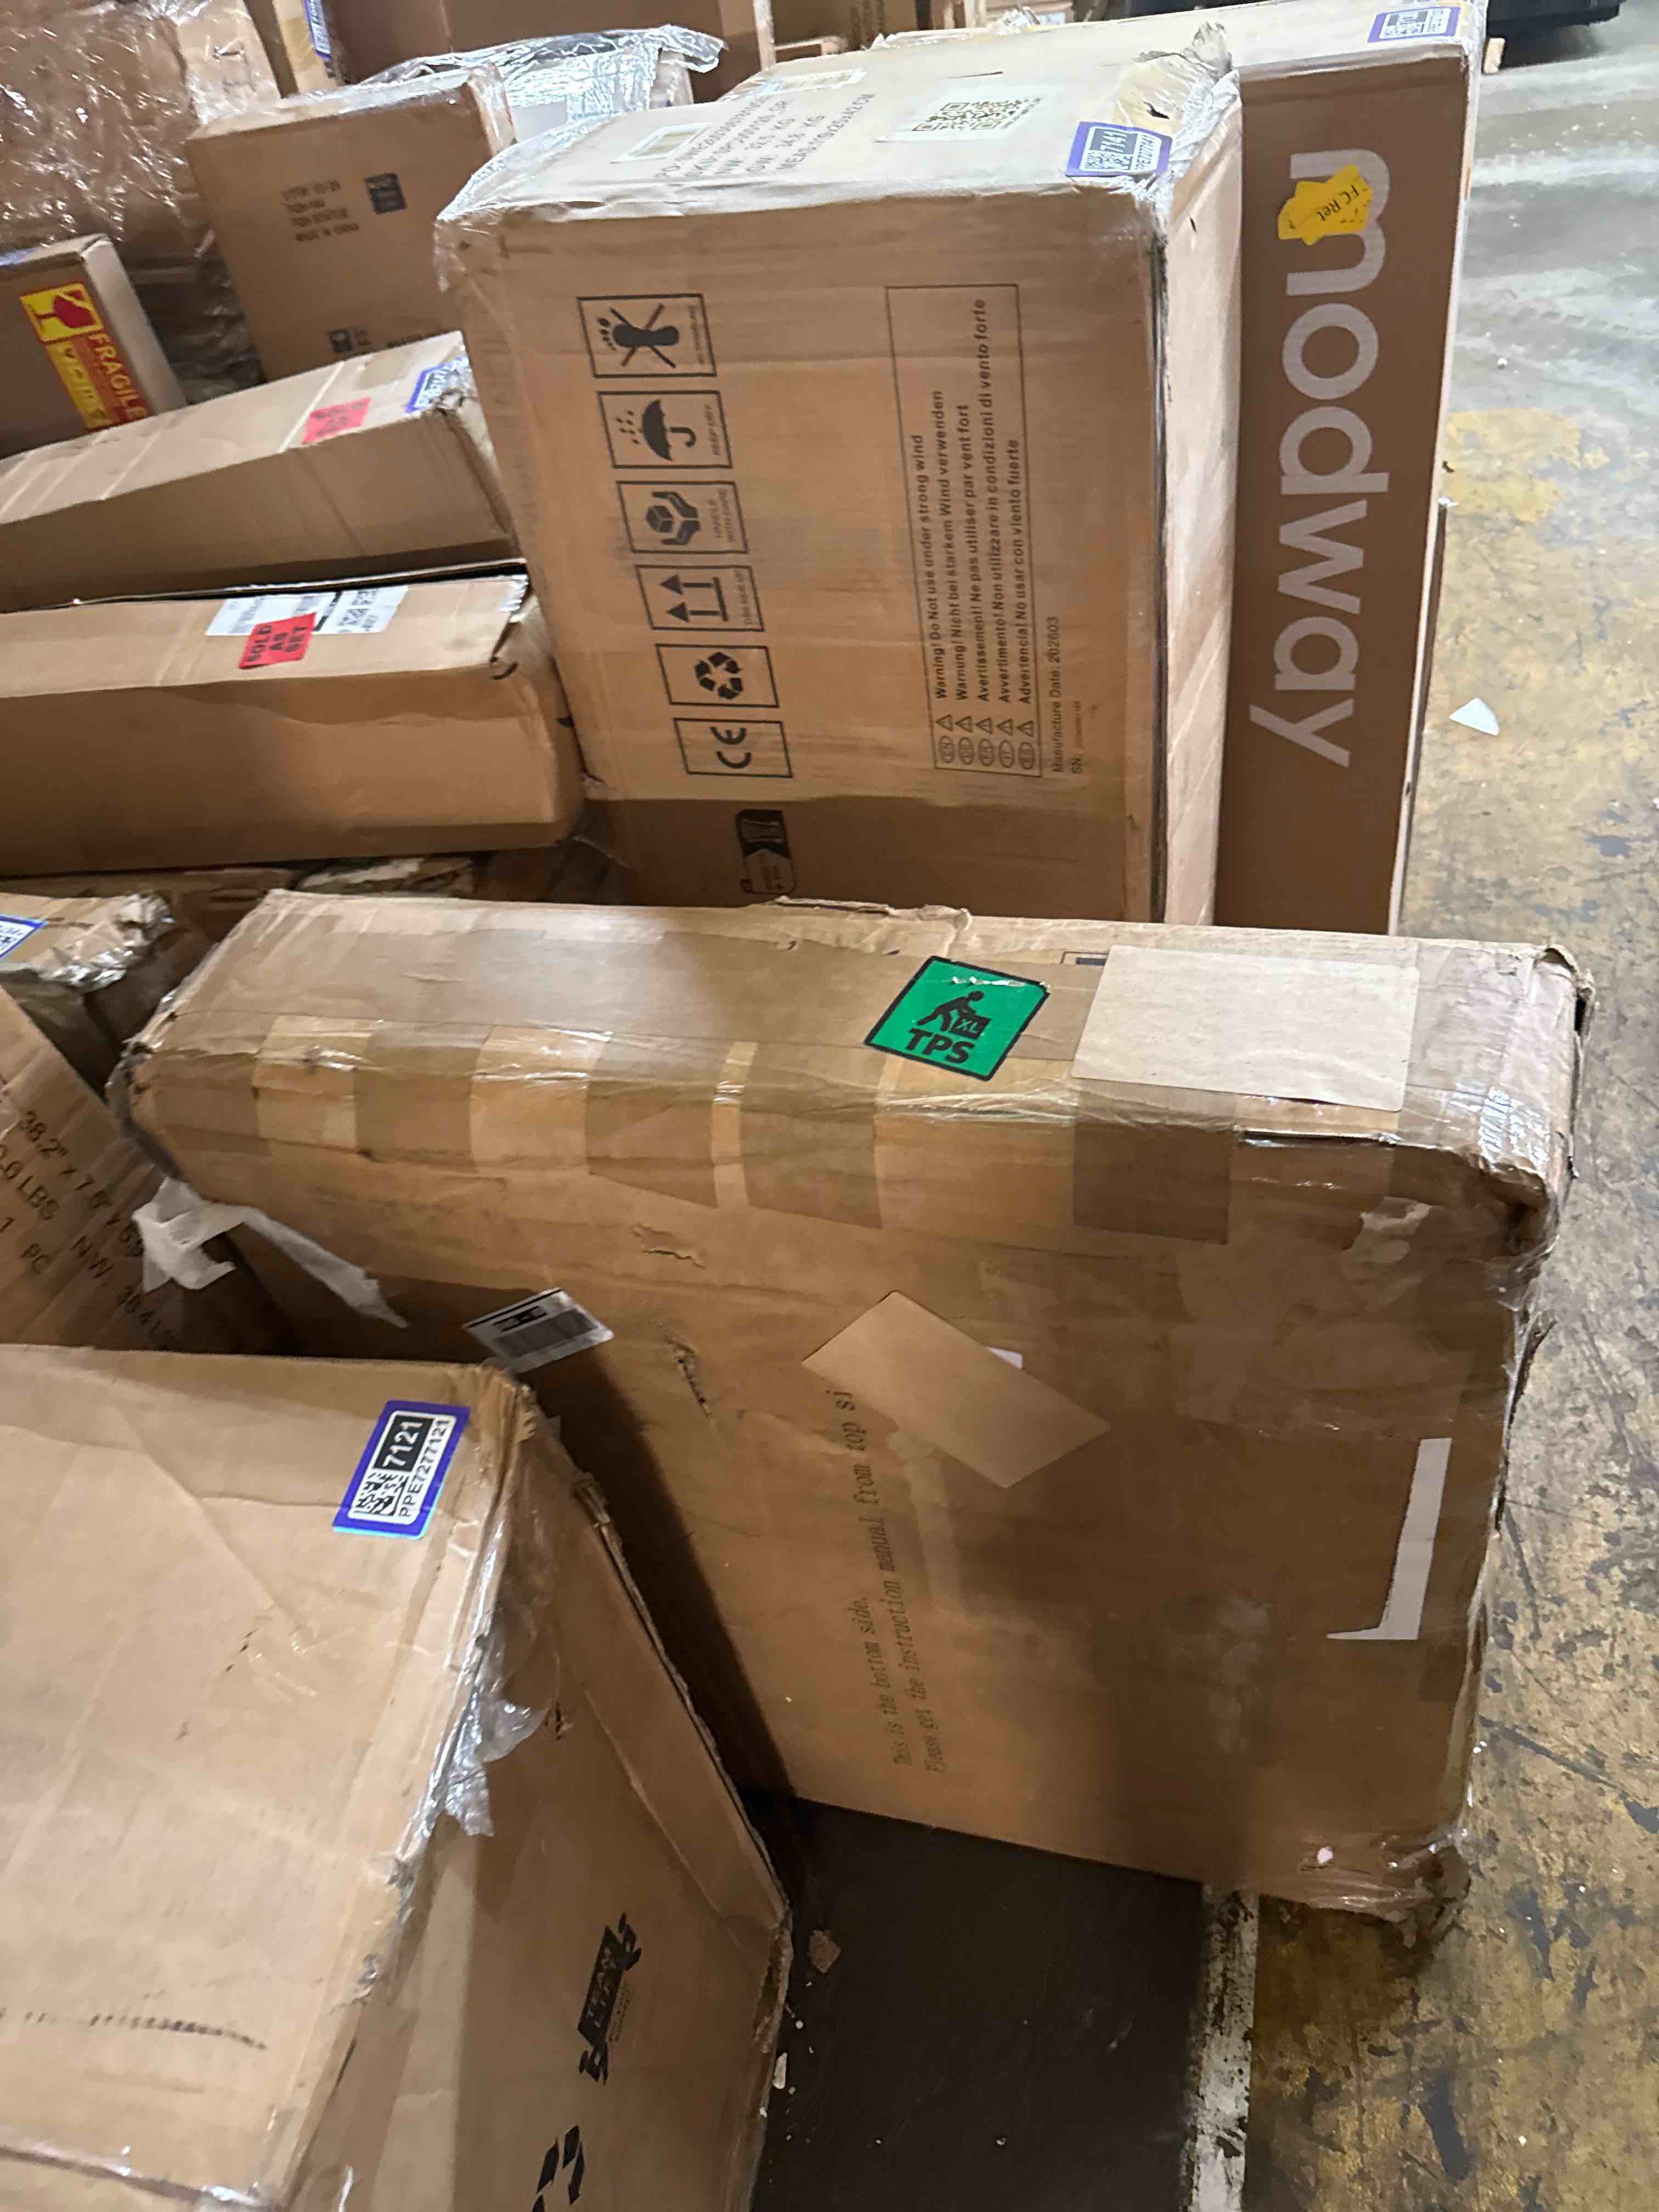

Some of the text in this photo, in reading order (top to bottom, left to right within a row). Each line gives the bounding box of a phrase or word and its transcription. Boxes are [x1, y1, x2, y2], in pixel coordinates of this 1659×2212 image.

[1100, 131, 1127, 153] 7141
[974, 299, 988, 341] forte
[88, 332, 149, 421] FRAGILE
[975, 343, 991, 388] vento
[956, 404, 970, 432] fort
[977, 393, 992, 408] di
[931, 390, 948, 475] verwenden
[911, 435, 925, 470] wind
[958, 437, 973, 470] vent
[979, 412, 998, 493] condizioni
[1006, 439, 1020, 485] fuerte
[1249, 148, 1390, 768] modway
[916, 475, 930, 522] strong
[937, 479, 951, 516] Wind
[963, 474, 977, 498] par
[985, 497, 999, 510] in
[963, 501, 978, 554] utiliser
[1008, 489, 1022, 534] viento
[919, 527, 934, 567] under
[942, 520, 957, 576] starkem
[988, 515, 1002, 580] utilizzare
[1013, 539, 1024, 565] con
[926, 571, 936, 594] use
[969, 557, 982, 581] pas
[1014, 568, 1026, 598] usar
[927, 597, 939, 620] Not
[946, 580, 959, 600] bei
[969, 584, 981, 602] Ne
[991, 584, 1005, 610] Non
[948, 603, 962, 637] Nicht
[1015, 602, 1027, 619] No
[247, 624, 272, 662] SOLD
[929, 623, 940, 640] Do
[932, 644, 947, 699] Warning!
[951, 641, 968, 700] Warnung!
[970, 606, 989, 702] Avertissement!
[992, 613, 1011, 703] Avvertimento!
[1015, 623, 1031, 704] Advertencia!
[1049, 665, 1062, 698] Date:
[709, 726, 752, 769] CE
[1051, 701, 1063, 773] Manufacture
[906, 1028, 975, 1063] TPS
[956, 1019, 978, 1034] XL
[17, 1175, 59, 1221] LBS
[384, 1421, 424, 1468] 7121
[842, 1421, 866, 1451] top
[399, 1419, 450, 1517] PPE7277121
[853, 1464, 879, 1506] from
[858, 1516, 896, 1573] manual
[881, 1579, 921, 1672] instruction
[904, 1678, 927, 1700] the
[914, 1708, 939, 1729] get
